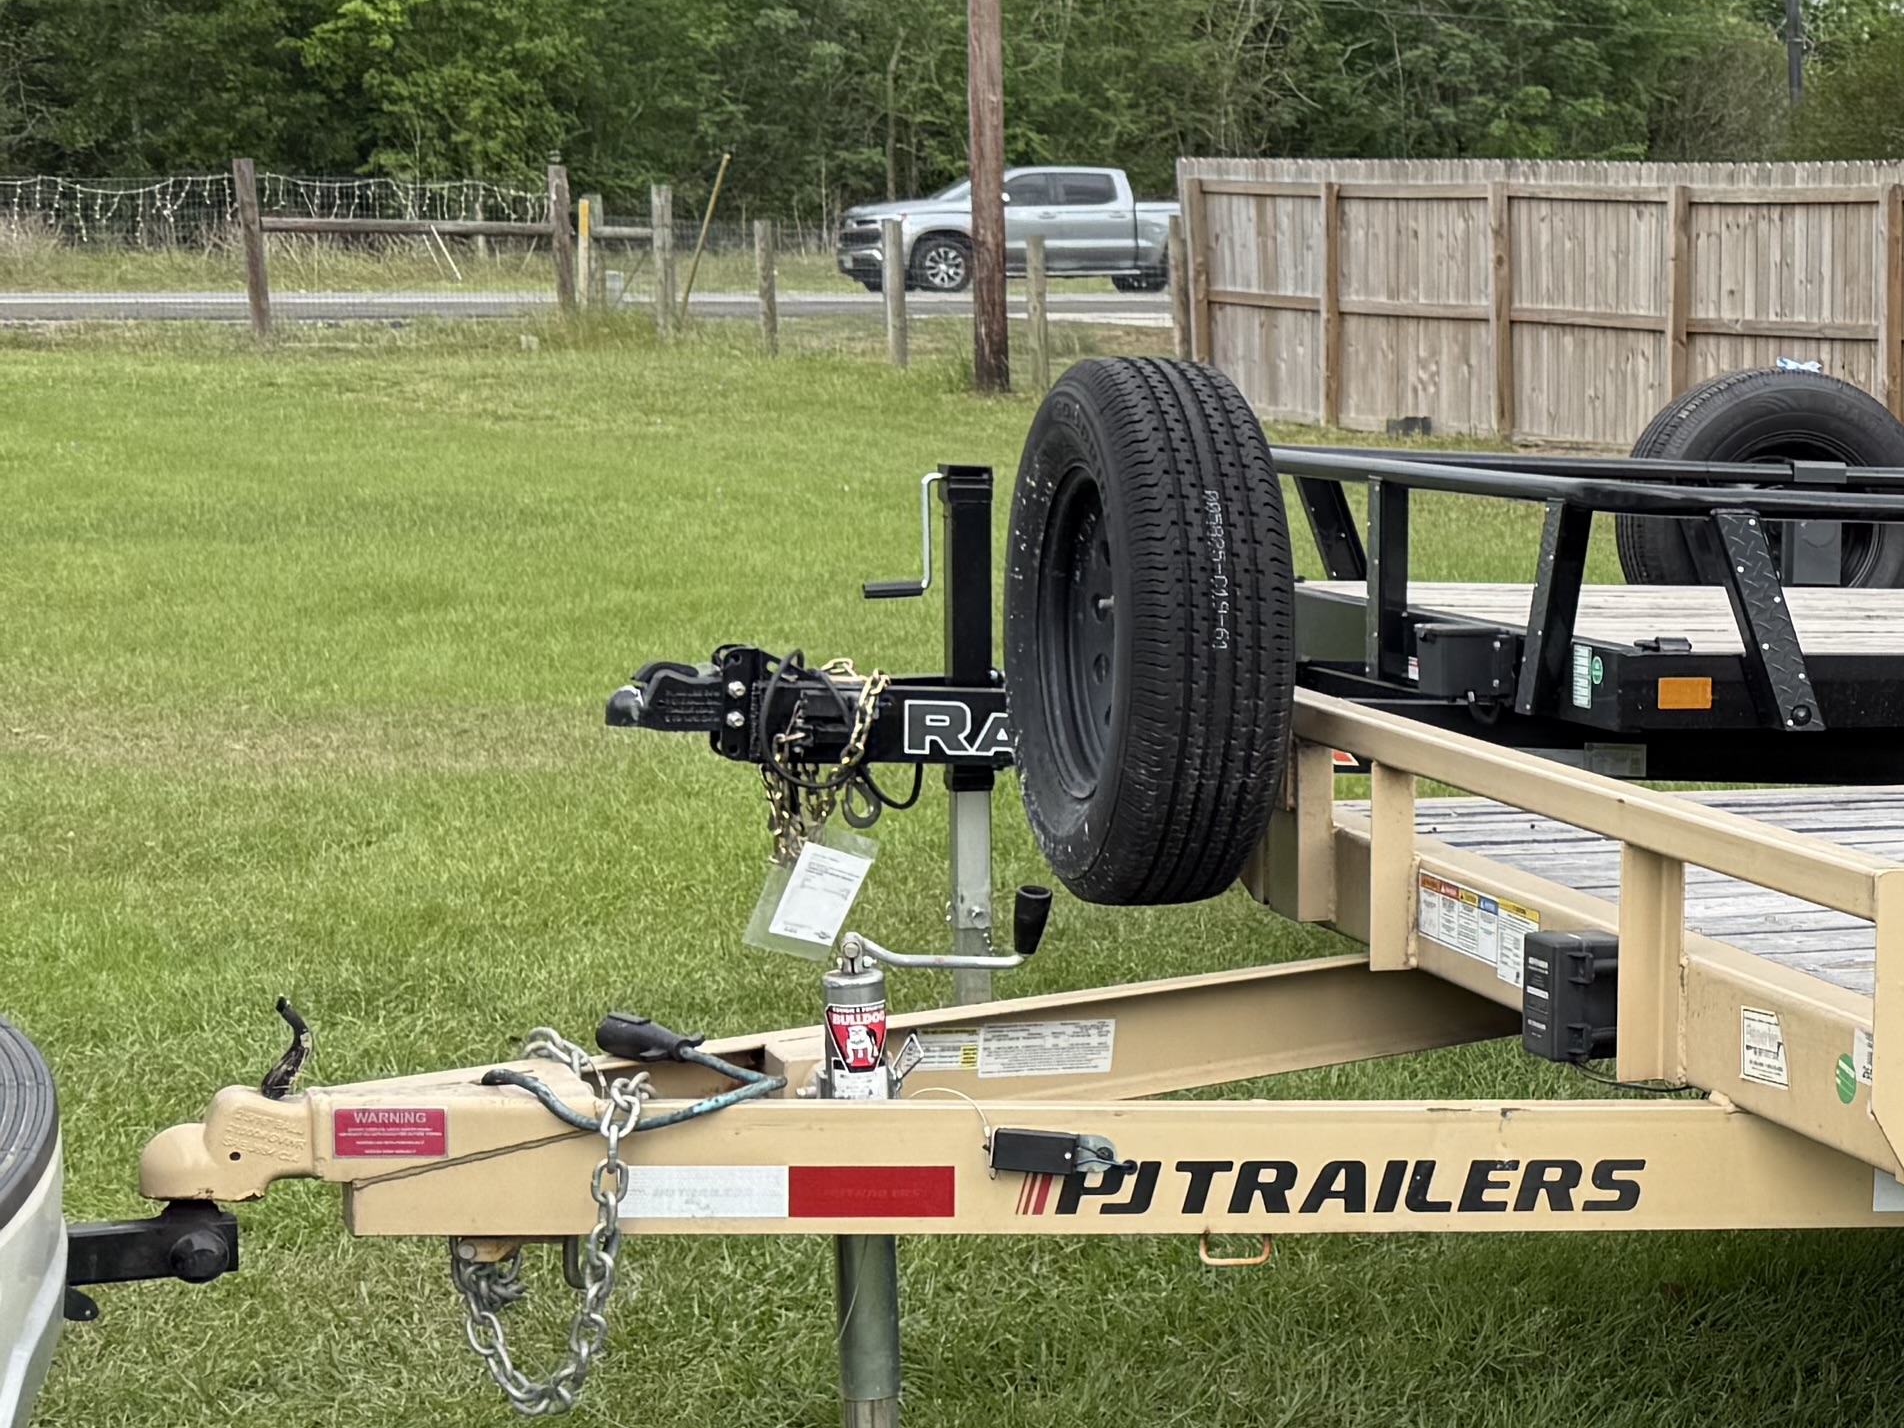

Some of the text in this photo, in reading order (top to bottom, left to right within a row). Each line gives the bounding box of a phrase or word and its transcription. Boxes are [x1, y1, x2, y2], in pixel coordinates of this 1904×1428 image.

[832, 1010, 884, 1025] BULLDOG
[353, 1111, 427, 1124] WARNING
[1055, 1159, 1646, 1214] PJ TRAILERS
